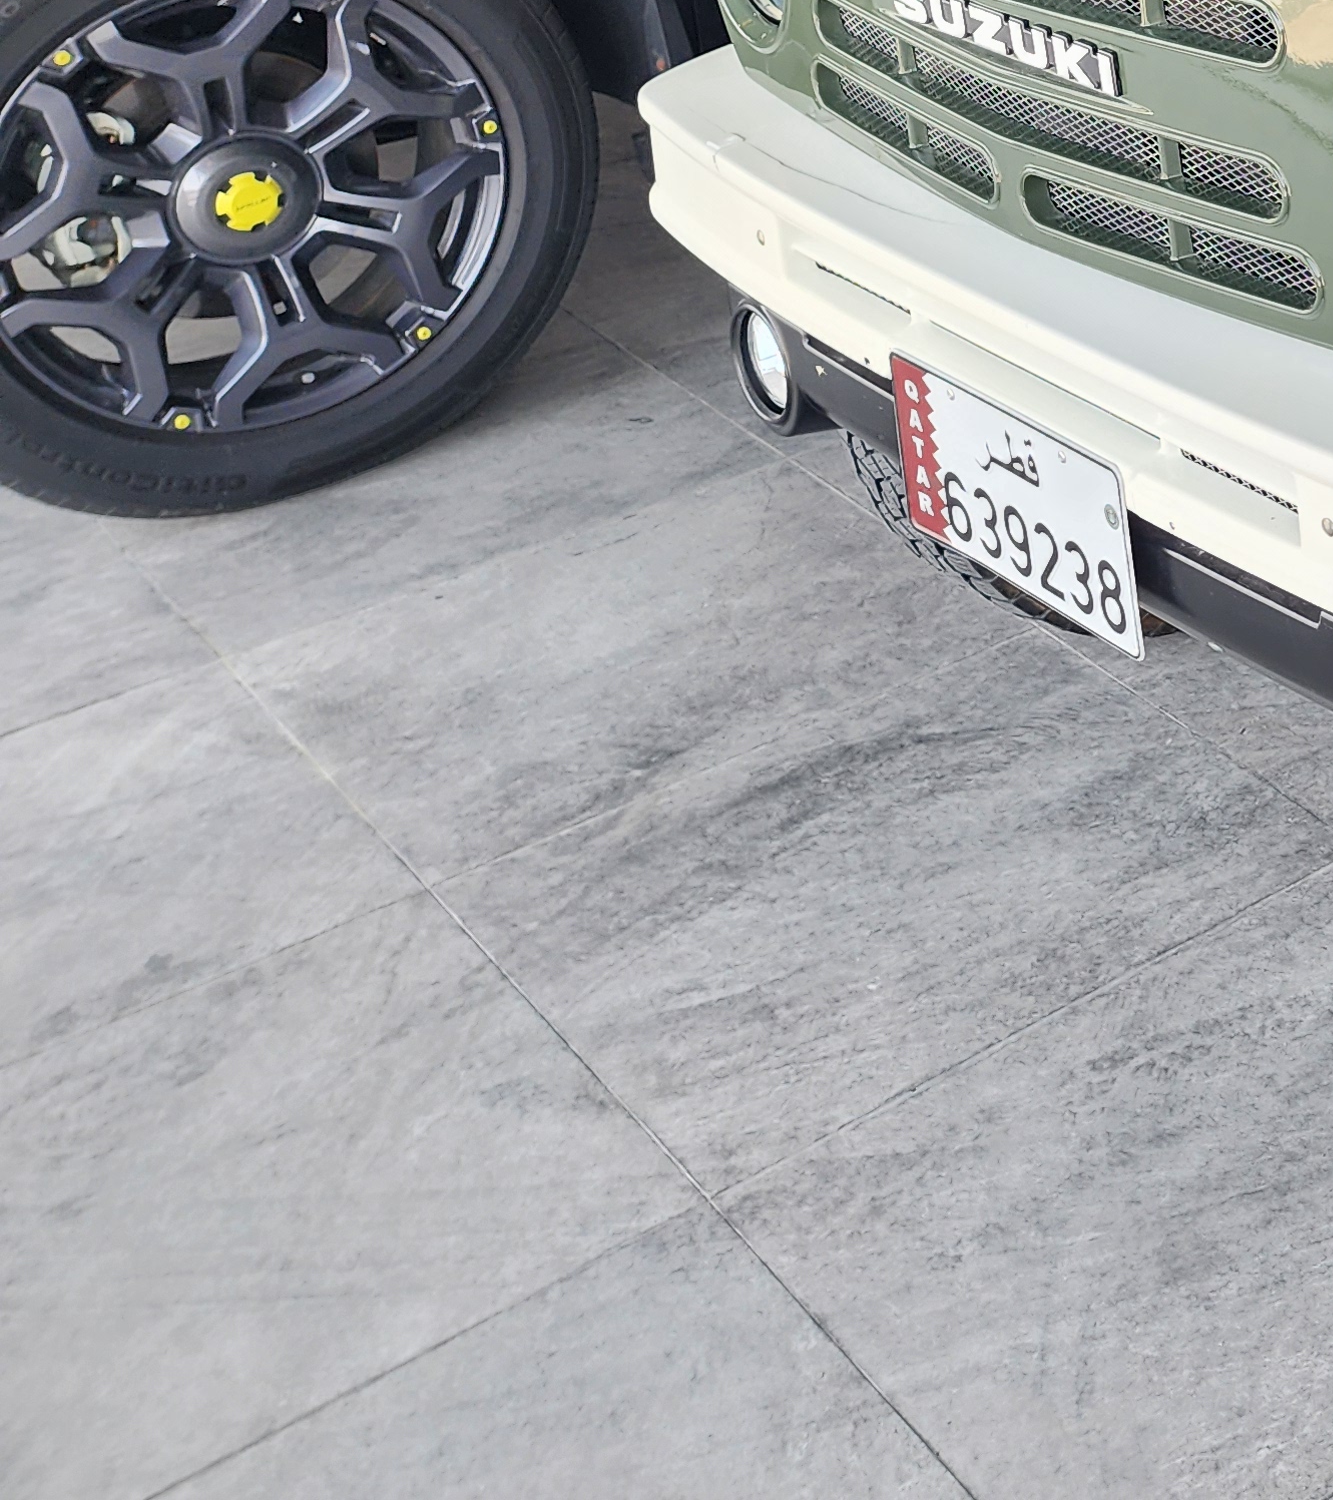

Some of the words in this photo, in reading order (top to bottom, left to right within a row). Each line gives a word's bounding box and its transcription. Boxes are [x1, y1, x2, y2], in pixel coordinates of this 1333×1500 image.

[904, 379, 934, 517] QATAR
[974, 430, 1039, 488] قطر
[944, 471, 1127, 635] 639238
